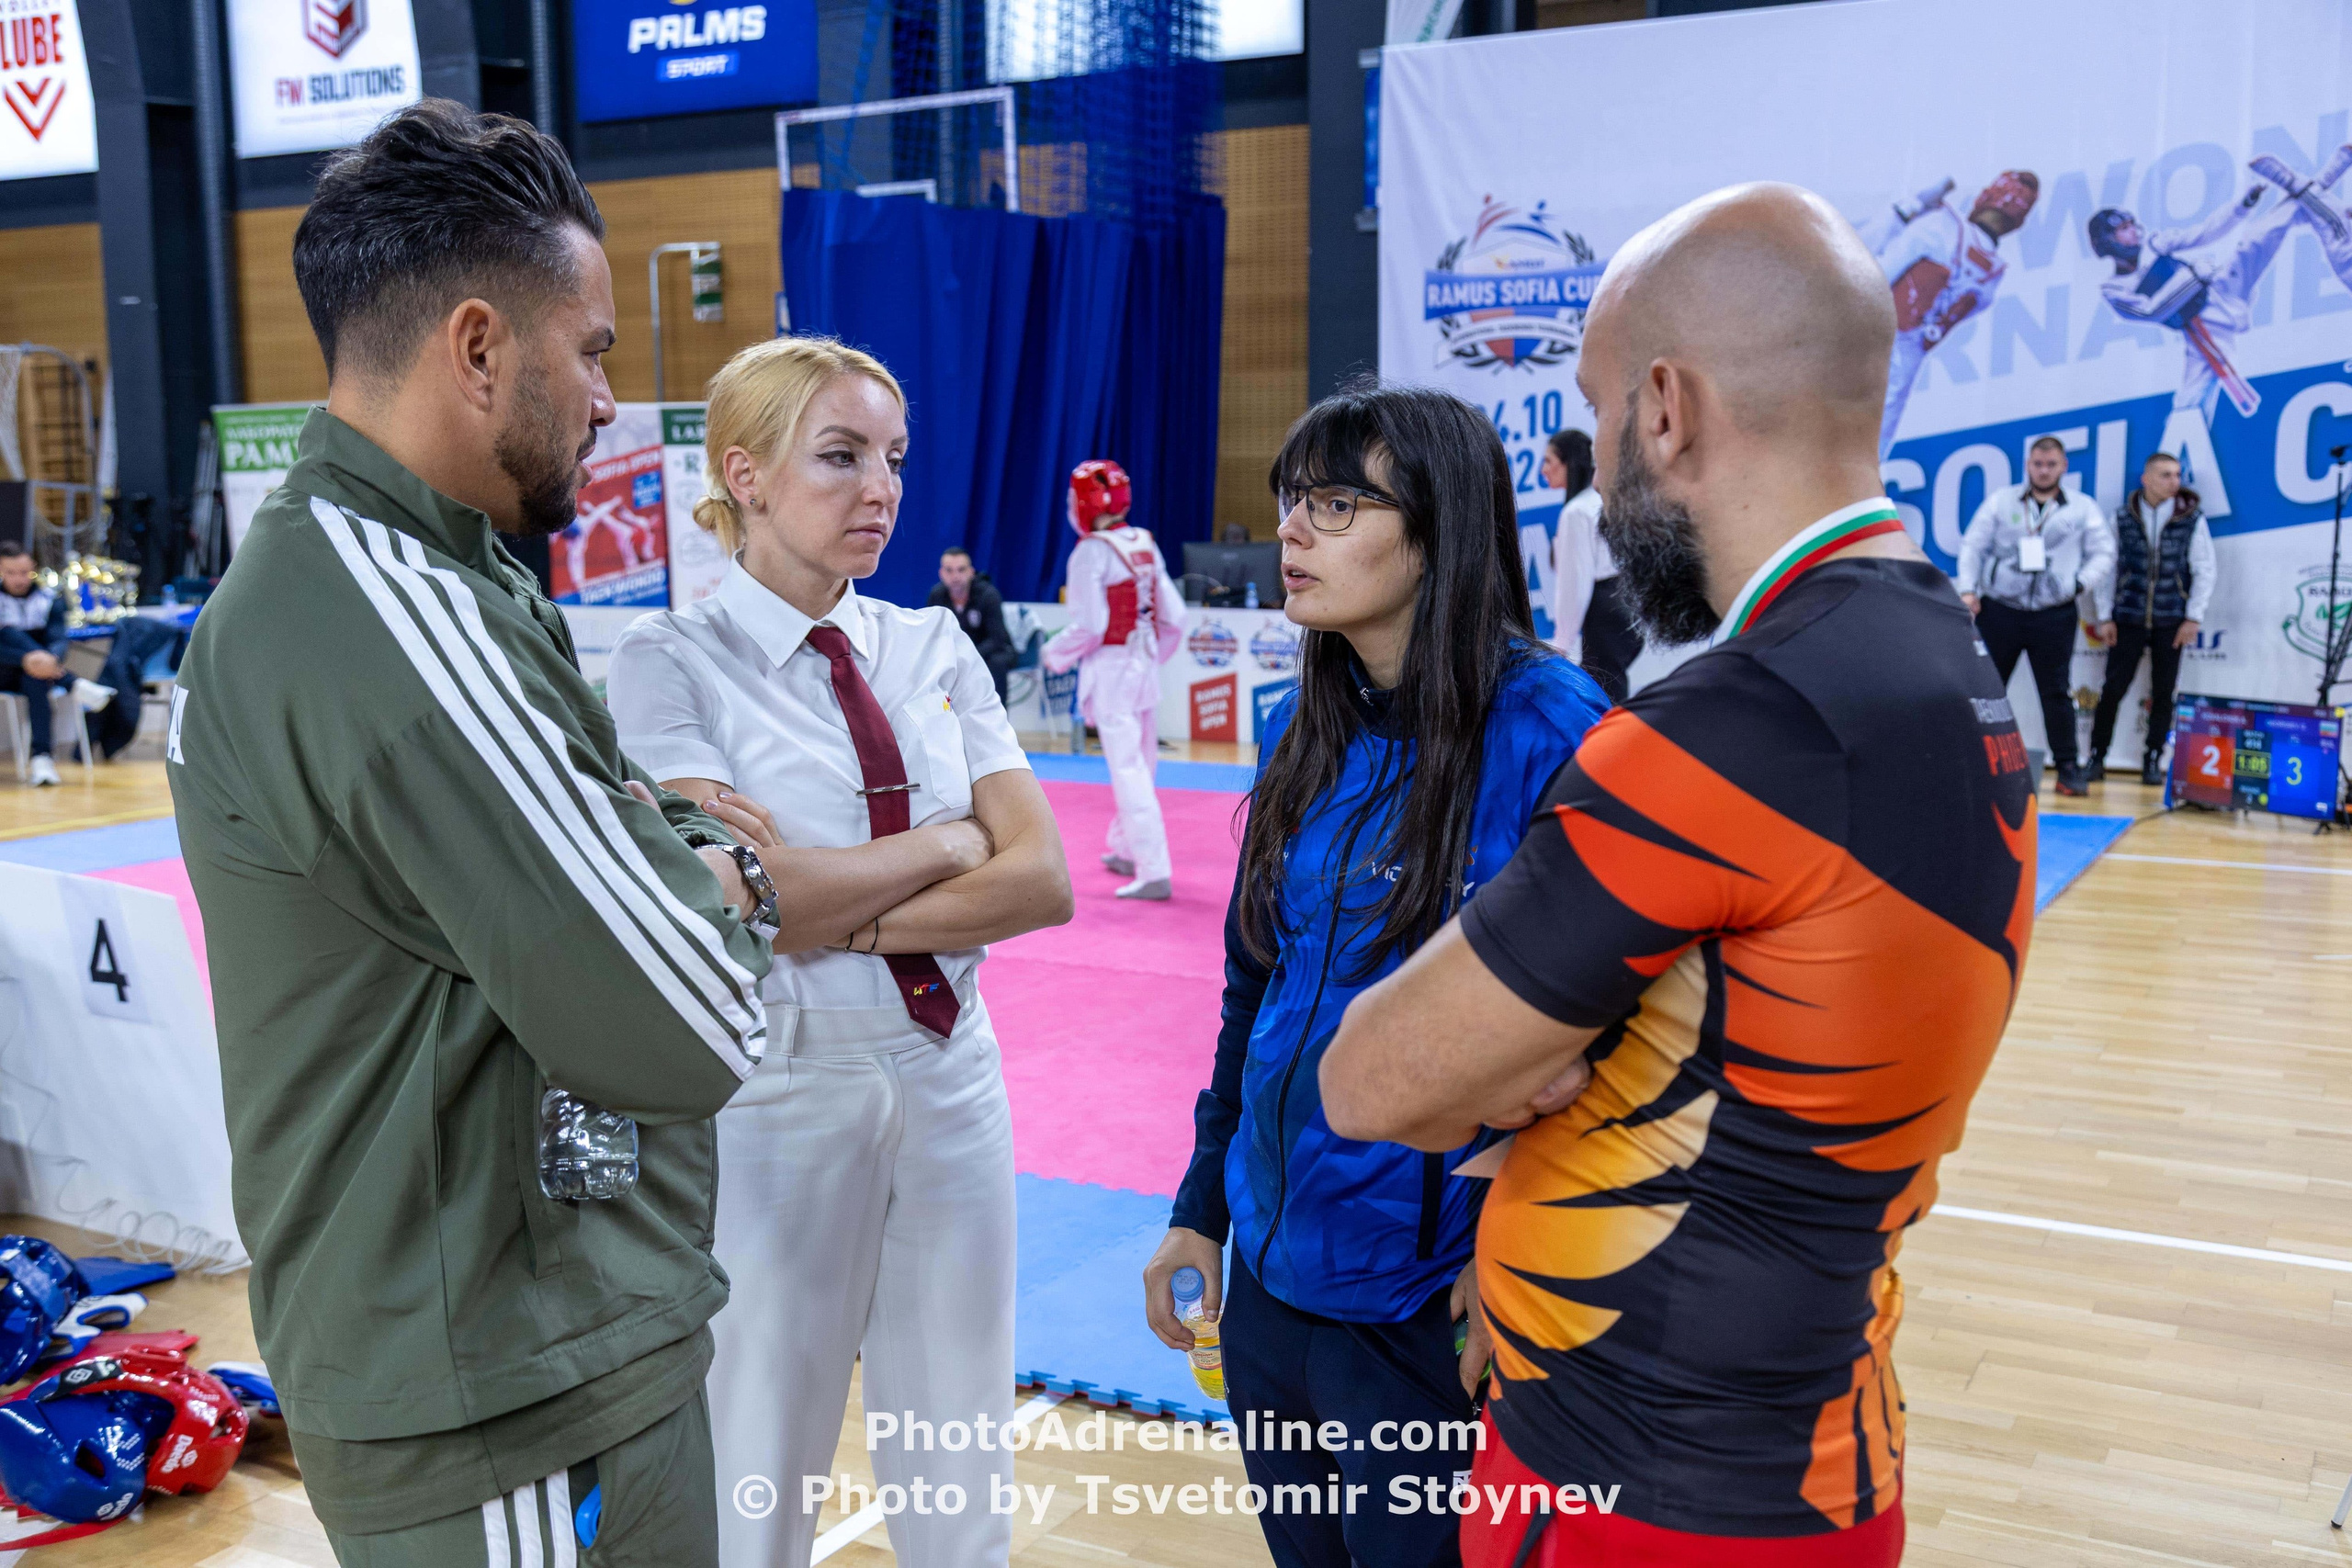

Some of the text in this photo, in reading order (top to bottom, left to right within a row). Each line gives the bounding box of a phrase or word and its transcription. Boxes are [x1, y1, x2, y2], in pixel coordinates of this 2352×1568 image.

[628, 5, 768, 53] PALMS
[666, 54, 729, 79] SPORT
[309, 63, 406, 104] SOLUTIONS
[1427, 279, 1497, 309] RAMUS
[1499, 277, 1560, 305] SOFIA
[1478, 389, 1563, 443] 4.10
[225, 440, 299, 468] РАМ
[2200, 745, 2221, 777] 2
[2286, 756, 2302, 786] 3
[91, 918, 130, 1003] 4
[913, 982, 940, 996] WTF
